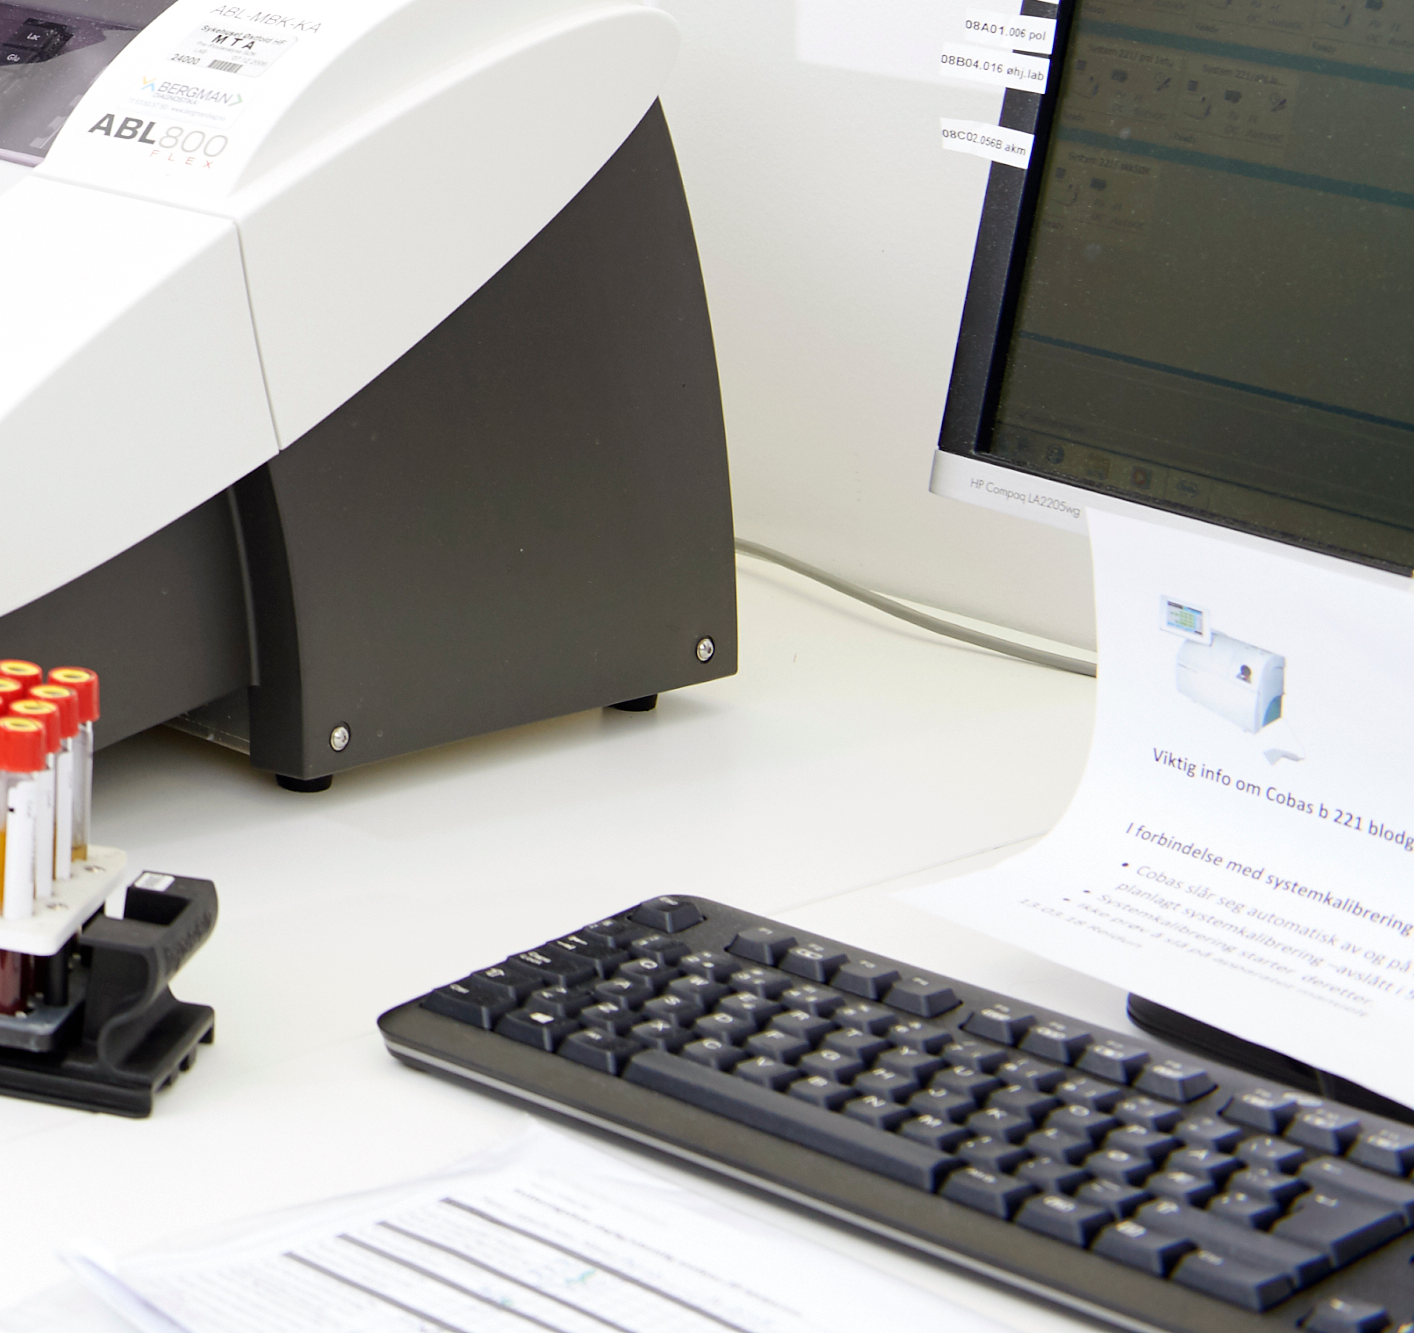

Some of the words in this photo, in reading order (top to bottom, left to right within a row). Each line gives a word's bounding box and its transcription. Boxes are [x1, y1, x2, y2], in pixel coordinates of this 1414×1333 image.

[209, 5, 322, 34] ABL-MBK-KA
[965, 19, 1026, 38] 08A01.006
[1028, 31, 1046, 41] pol
[941, 54, 1003, 73] 08B04.016
[157, 81, 234, 104] BERGMAN
[942, 129, 1003, 149] 08C02.056B
[1004, 144, 1026, 155] akm
[970, 478, 985, 489] HP
[986, 481, 1026, 505] Compaq
[1028, 493, 1081, 518] LA2205wg
[1153, 748, 1197, 778] Viktig
[1200, 764, 1231, 786] info
[1235, 779, 1261, 796] om
[1265, 787, 1313, 814] Cobas
[1318, 803, 1328, 819] b
[1333, 809, 1363, 831] 221
[1368, 820, 1414, 852] blodg
[1135, 824, 1223, 866] forbindelse
[1225, 858, 1266, 880] med
[1266, 873, 1414, 937] systemkalibrering
[1097, 893, 1238, 953] Systemkalibrering
[1114, 881, 1181, 914] planlagt
[1181, 905, 1325, 969] systemkalibrering
[1136, 866, 1184, 890] Cobas
[1184, 882, 1216, 902] slår
[1216, 895, 1246, 915] seg
[1246, 906, 1337, 947] automatisk
[1341, 941, 1361, 954] av
[1363, 950, 1388, 967] og
[1389, 955, 1413, 974] på
